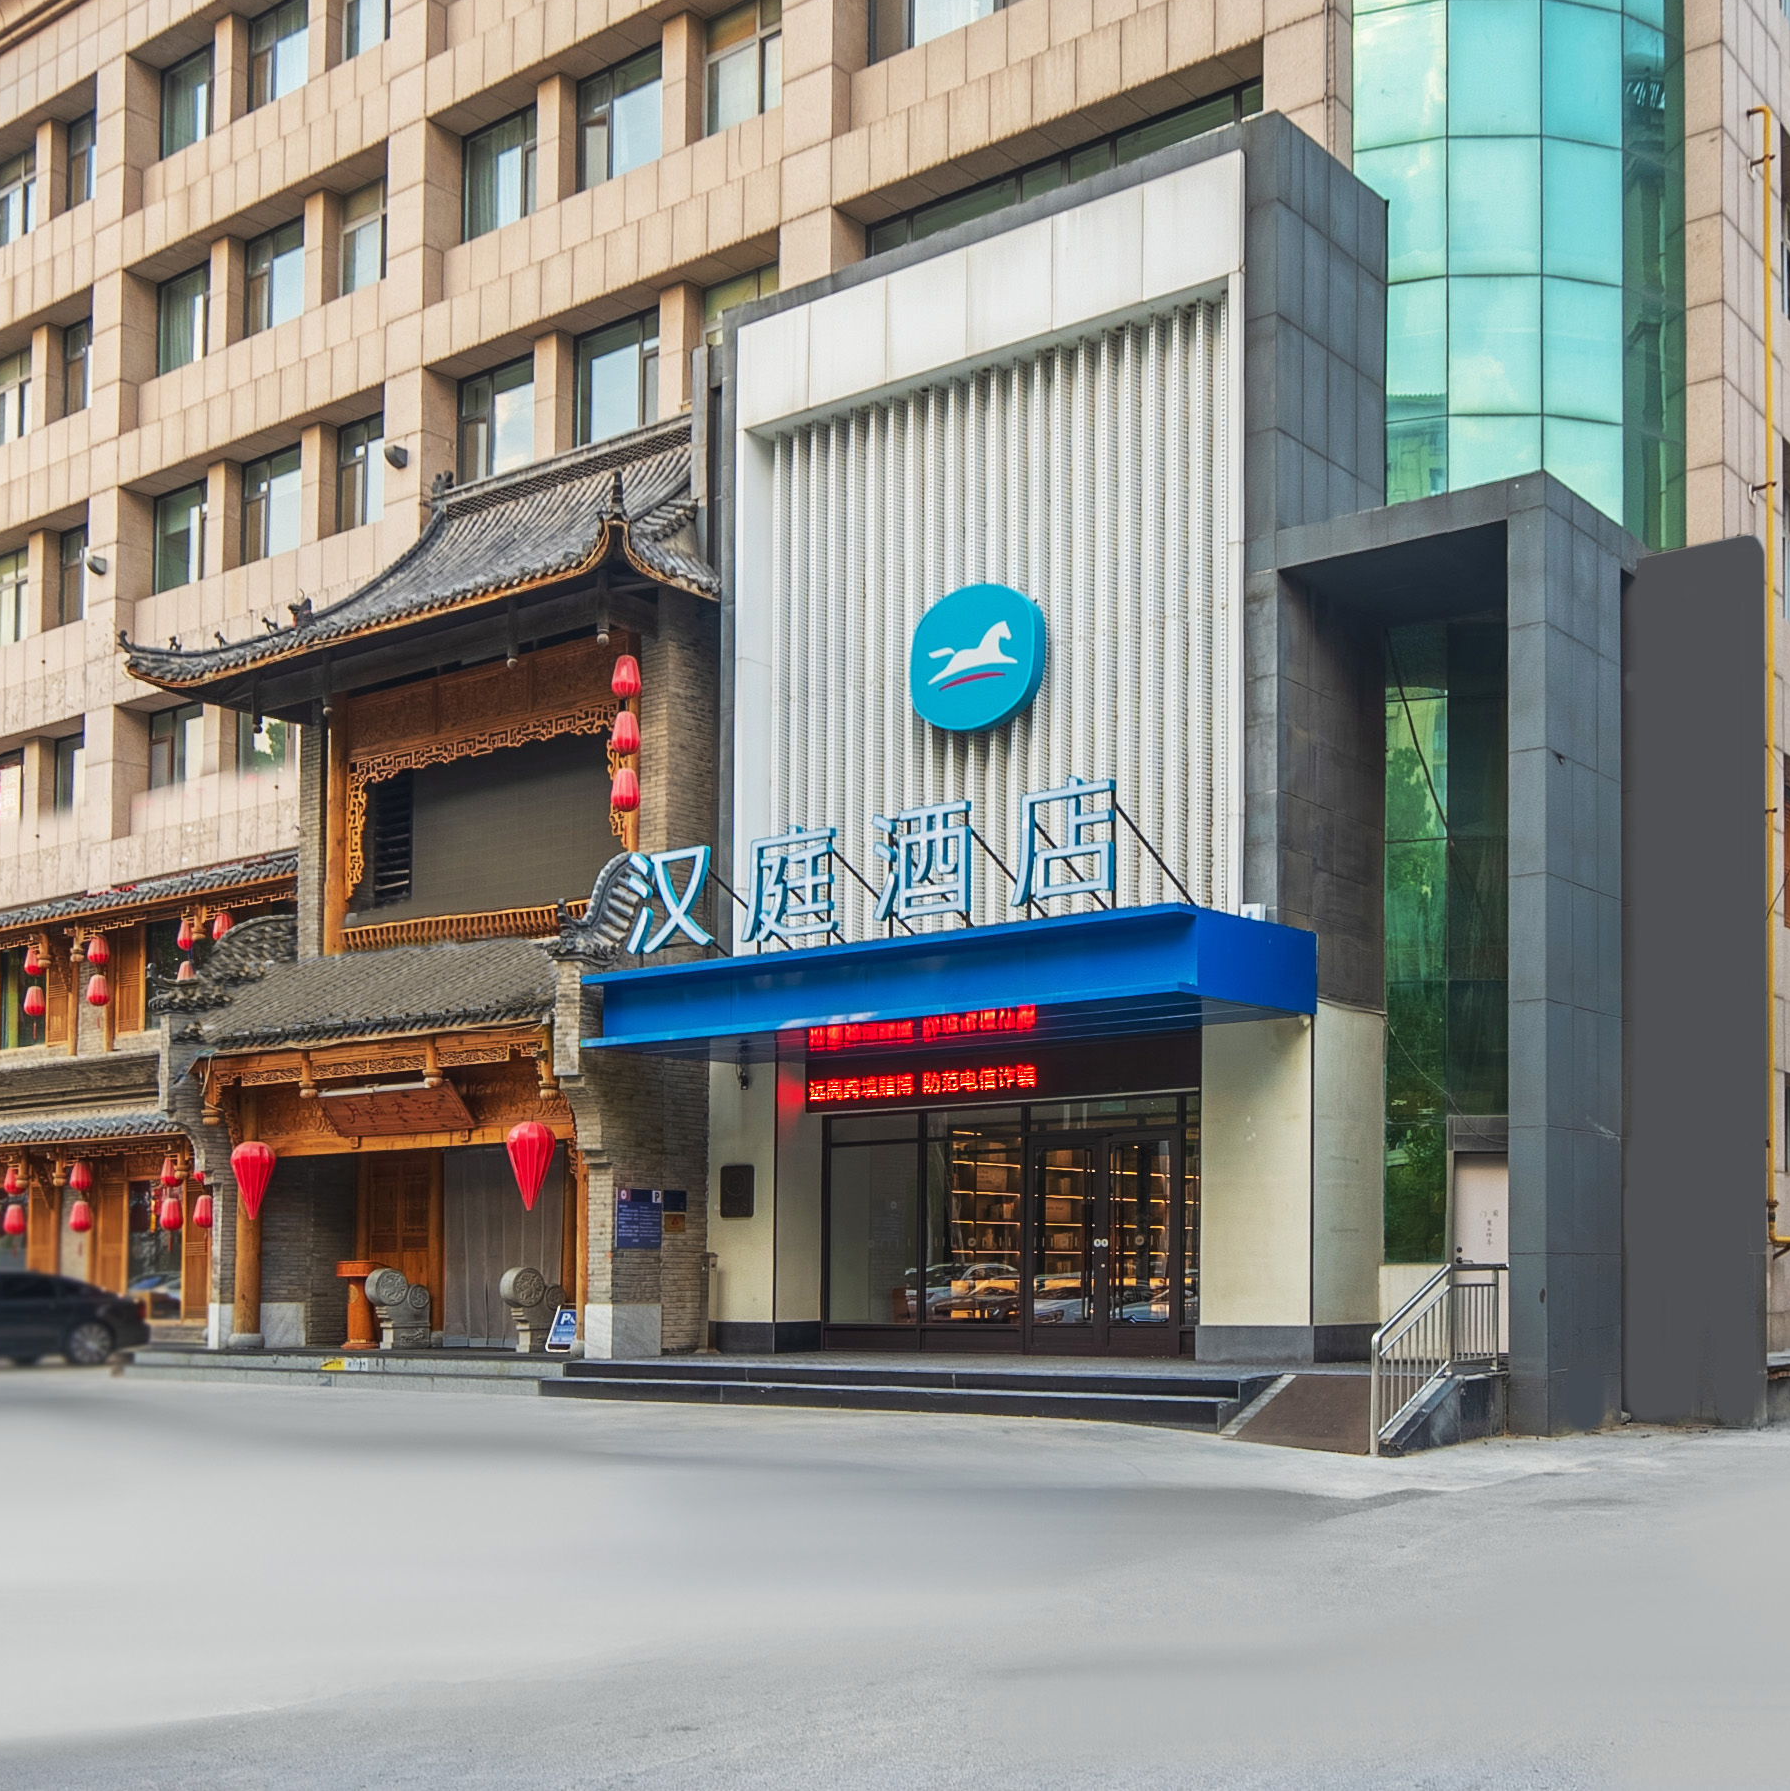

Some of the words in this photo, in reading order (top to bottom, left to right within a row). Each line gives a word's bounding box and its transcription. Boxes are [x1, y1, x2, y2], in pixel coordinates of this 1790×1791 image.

[626, 776, 1116, 955] 汉庭酒店
[808, 1073, 915, 1103] 远离跨境赌博
[921, 1064, 1038, 1095] 防范电信诈骗
